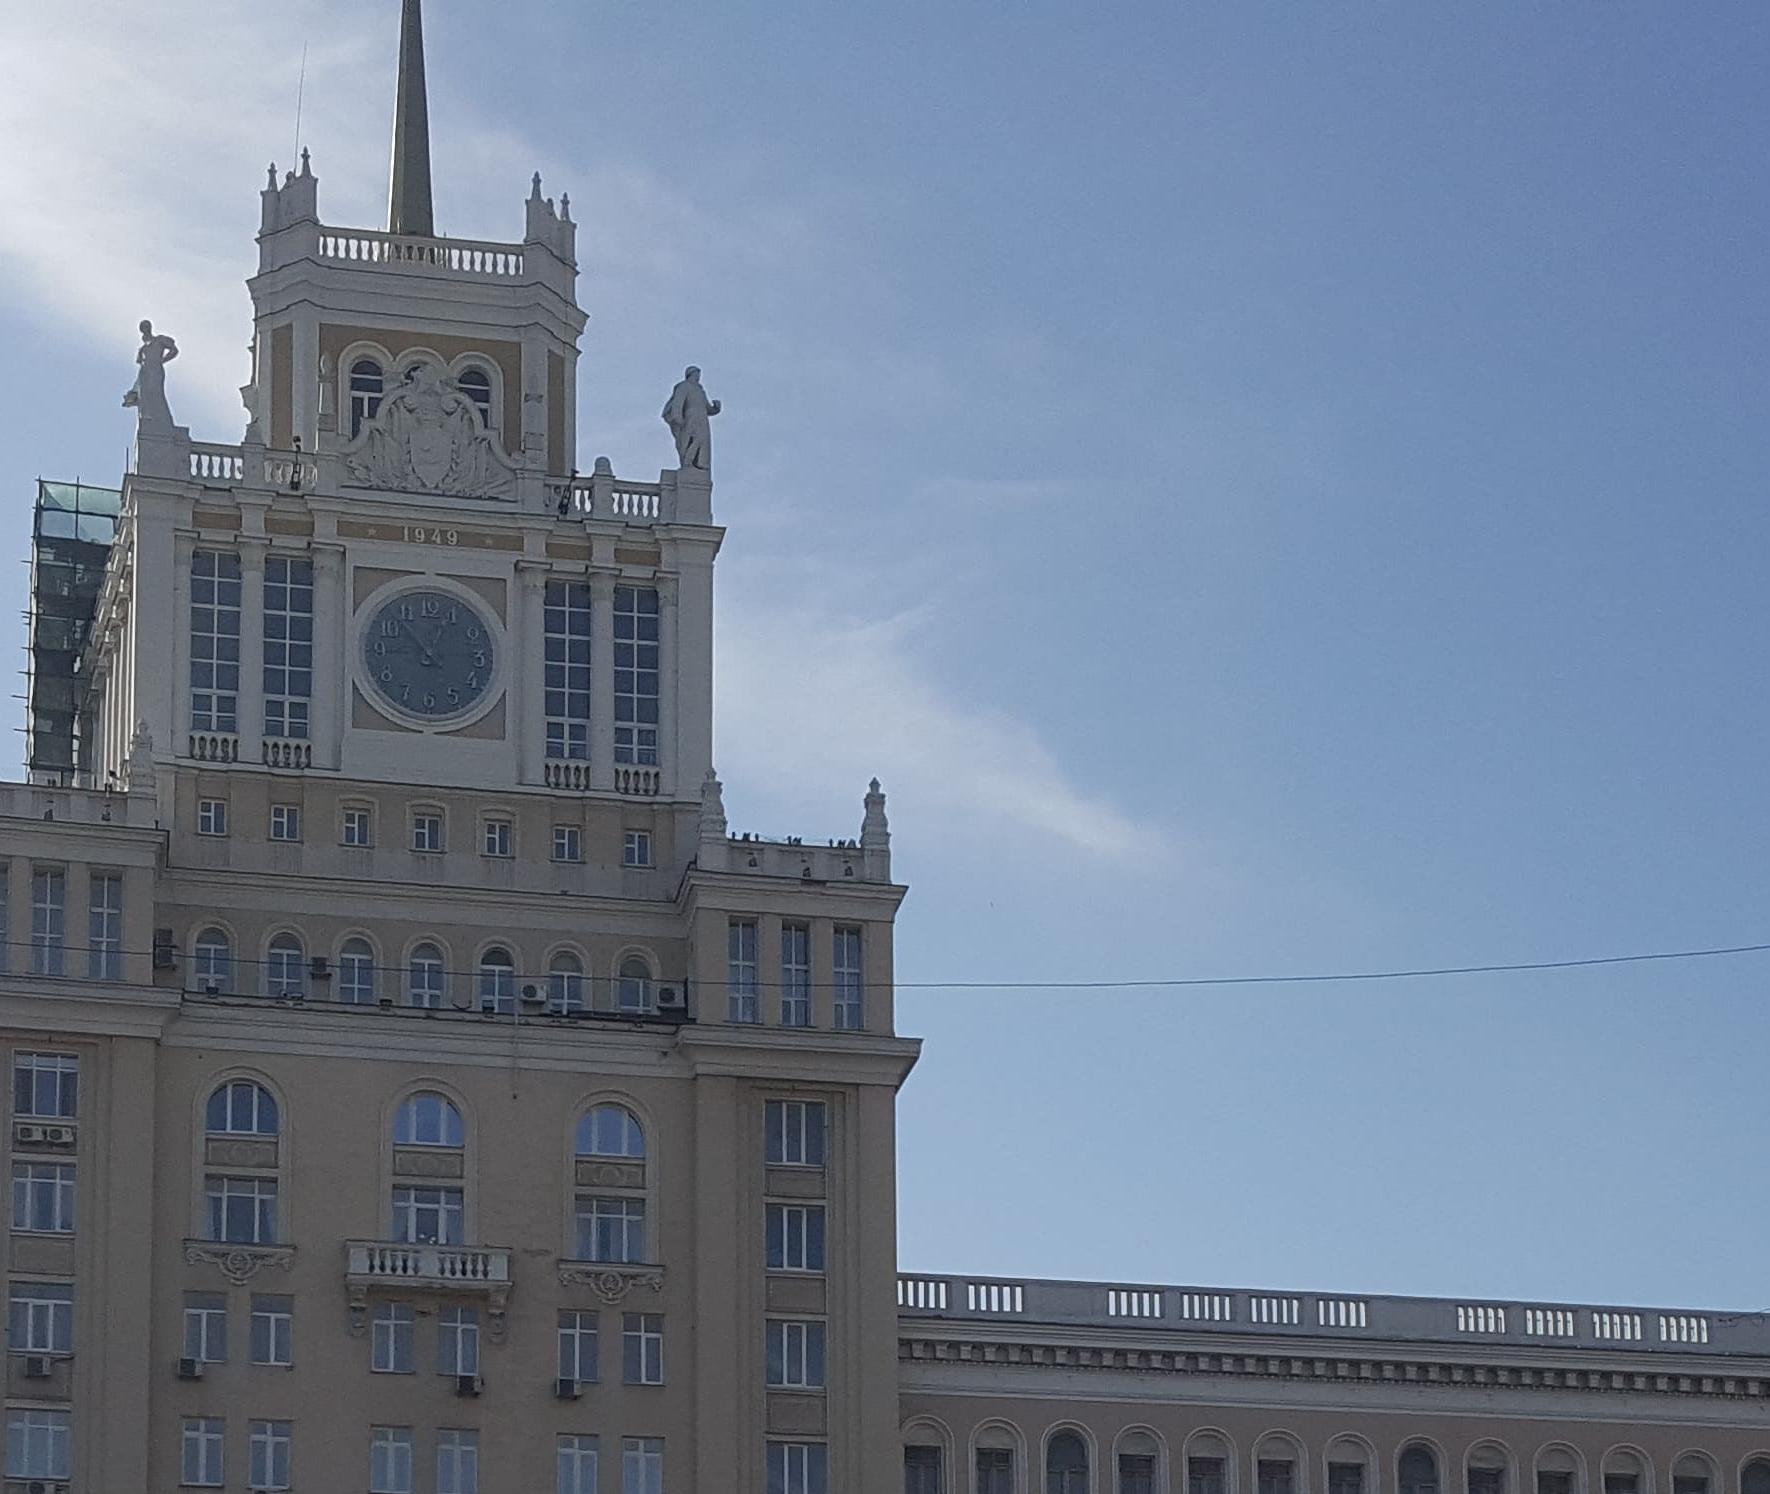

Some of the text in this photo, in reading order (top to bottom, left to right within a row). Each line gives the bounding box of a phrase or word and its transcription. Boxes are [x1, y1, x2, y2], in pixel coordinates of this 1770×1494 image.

[403, 526, 459, 545] 1949
[400, 604, 414, 621] 11
[420, 601, 440, 619] 12
[380, 620, 399, 638] 10
[374, 642, 386, 657] 9
[473, 650, 485, 668] 3
[381, 665, 393, 682] 8
[467, 671, 478, 689] 4
[401, 683, 411, 701] 7
[423, 693, 435, 709] 6
[448, 687, 459, 705] 5
